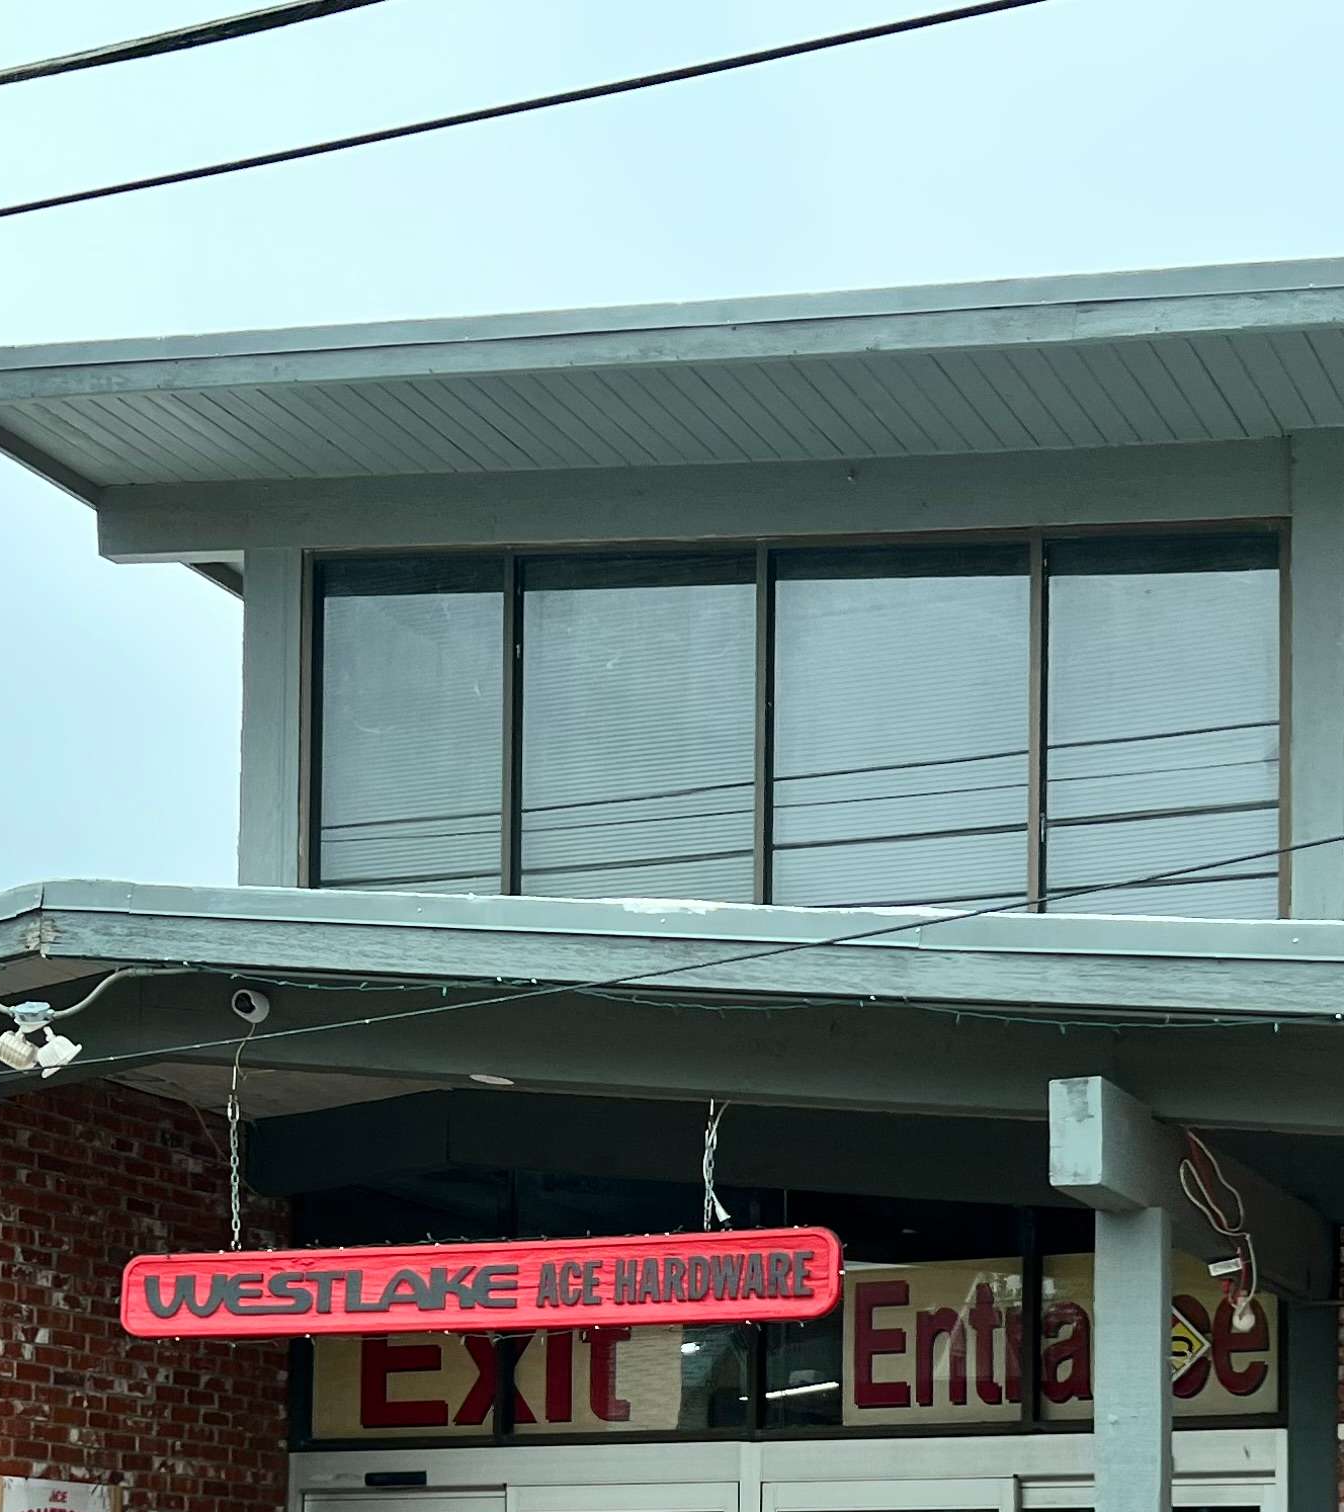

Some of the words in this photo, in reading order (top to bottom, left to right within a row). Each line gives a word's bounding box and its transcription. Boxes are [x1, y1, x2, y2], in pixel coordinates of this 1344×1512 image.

[144, 1263, 519, 1318] WESTLAKE
[537, 1259, 602, 1307] ACE
[614, 1250, 814, 1305] HARDWARE
